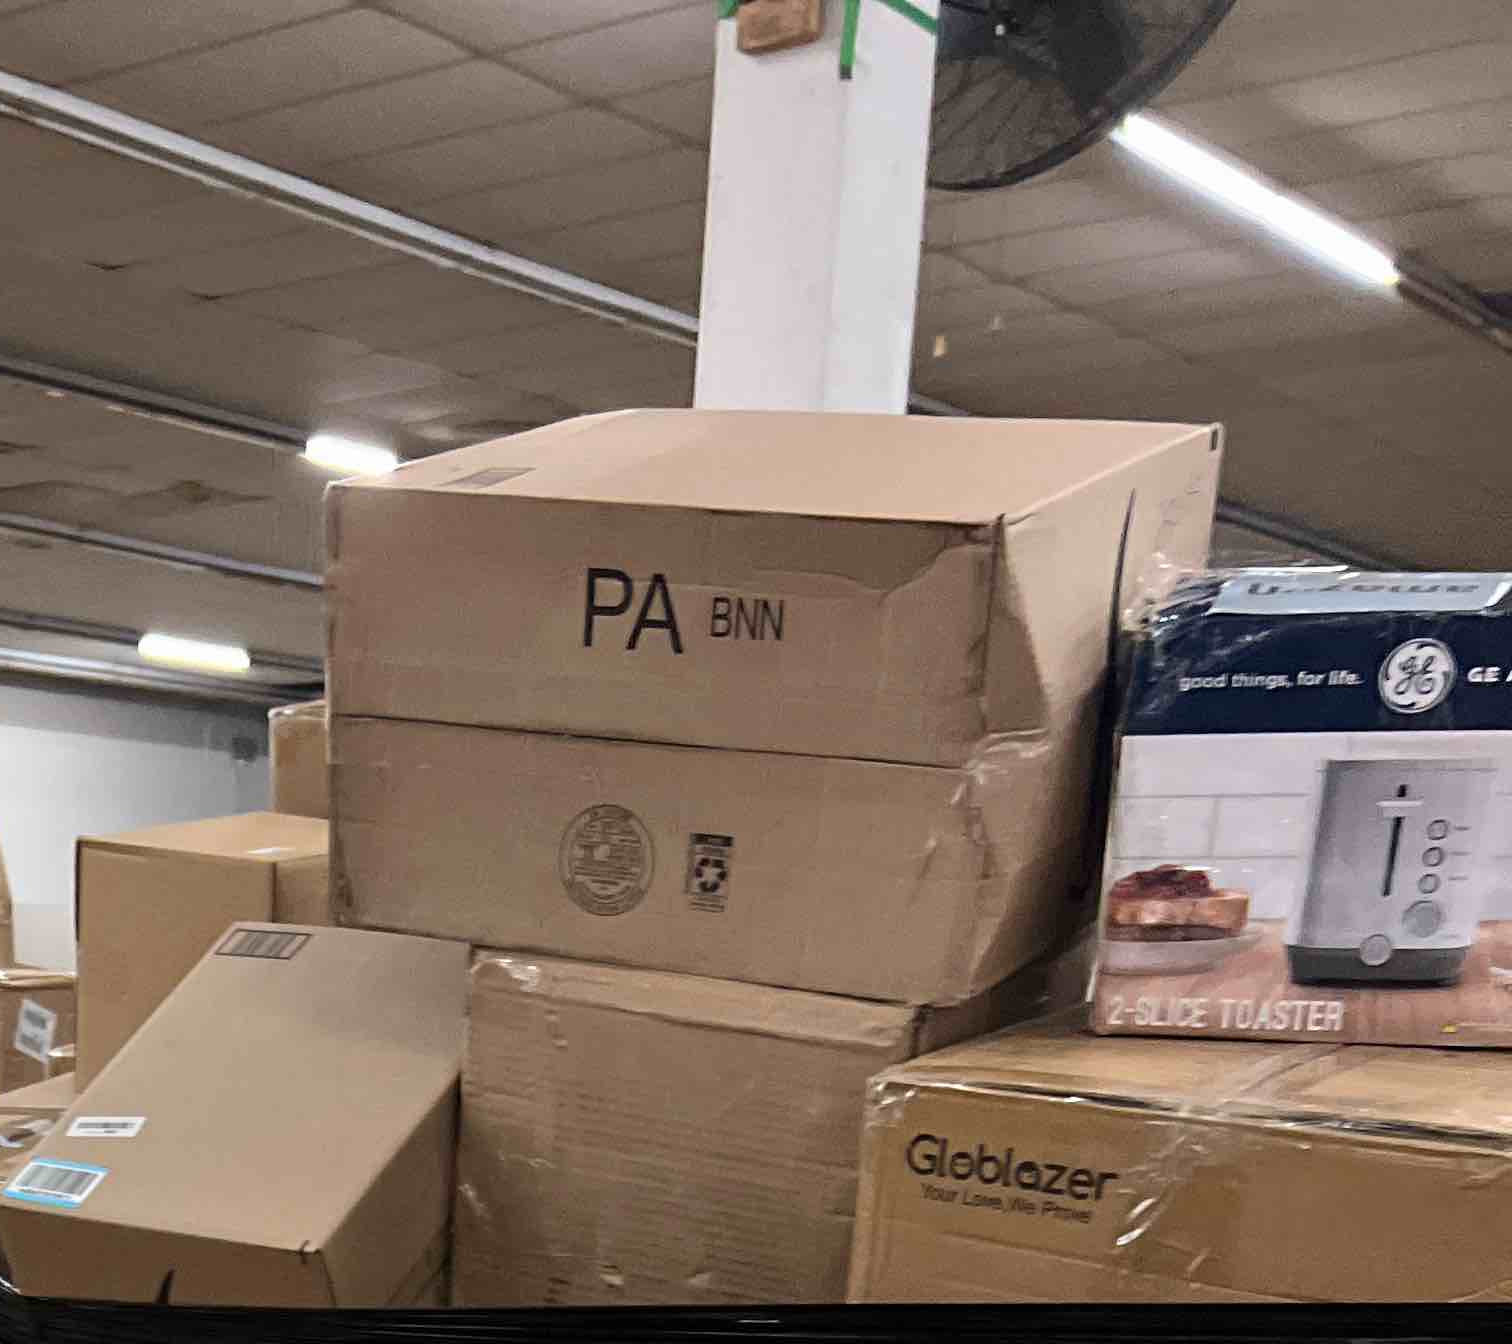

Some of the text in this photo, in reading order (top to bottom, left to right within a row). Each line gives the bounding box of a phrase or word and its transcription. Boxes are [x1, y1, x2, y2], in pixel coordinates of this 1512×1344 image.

[583, 567, 785, 654] PA BNN
[1466, 667, 1501, 684] GE
[1219, 999, 1345, 1032] TOASTER
